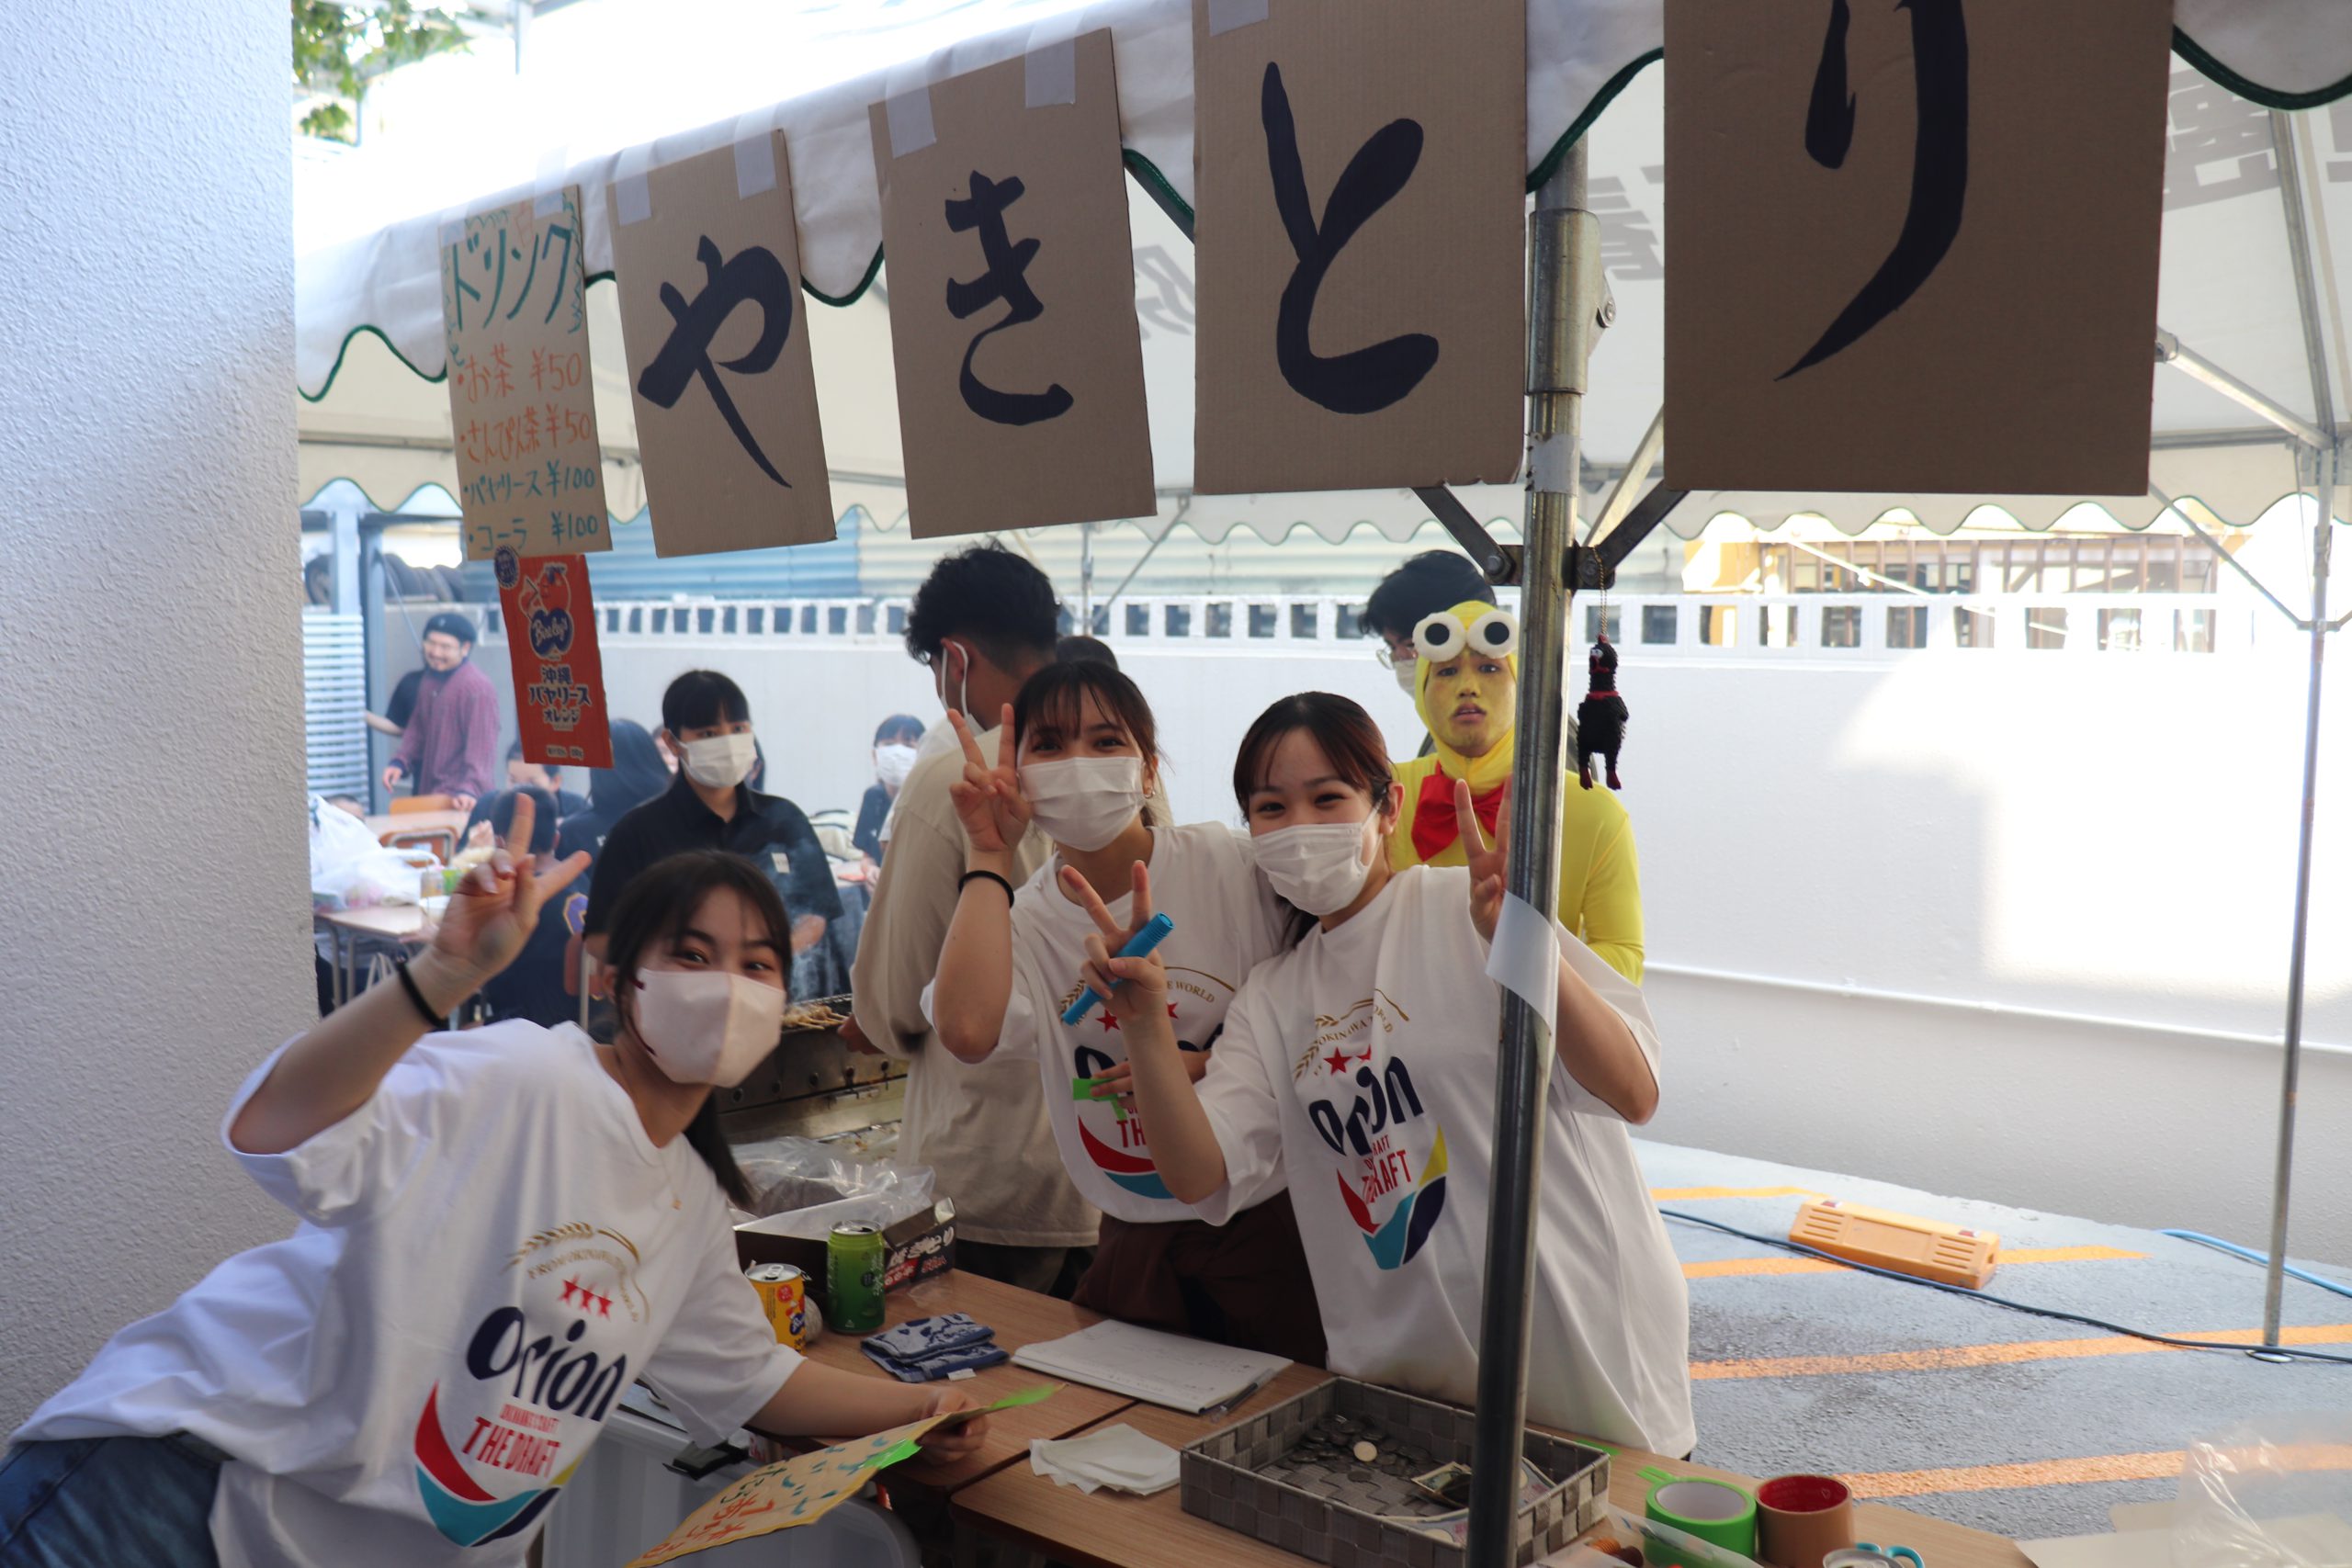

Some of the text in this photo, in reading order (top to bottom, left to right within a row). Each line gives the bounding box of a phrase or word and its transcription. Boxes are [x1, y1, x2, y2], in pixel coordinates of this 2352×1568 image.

[452, 223, 571, 333] ドリンク
[465, 343, 582, 404] お茶 ¥50
[546, 402, 593, 449] ¥50
[546, 459, 595, 499] ¥100
[476, 511, 599, 551] コーラ ¥100
[1175, 980, 1216, 1004] WORLD
[1308, 1055, 1424, 1157] Oron
[466, 1305, 627, 1423] Orion
[461, 1416, 514, 1468] THE
